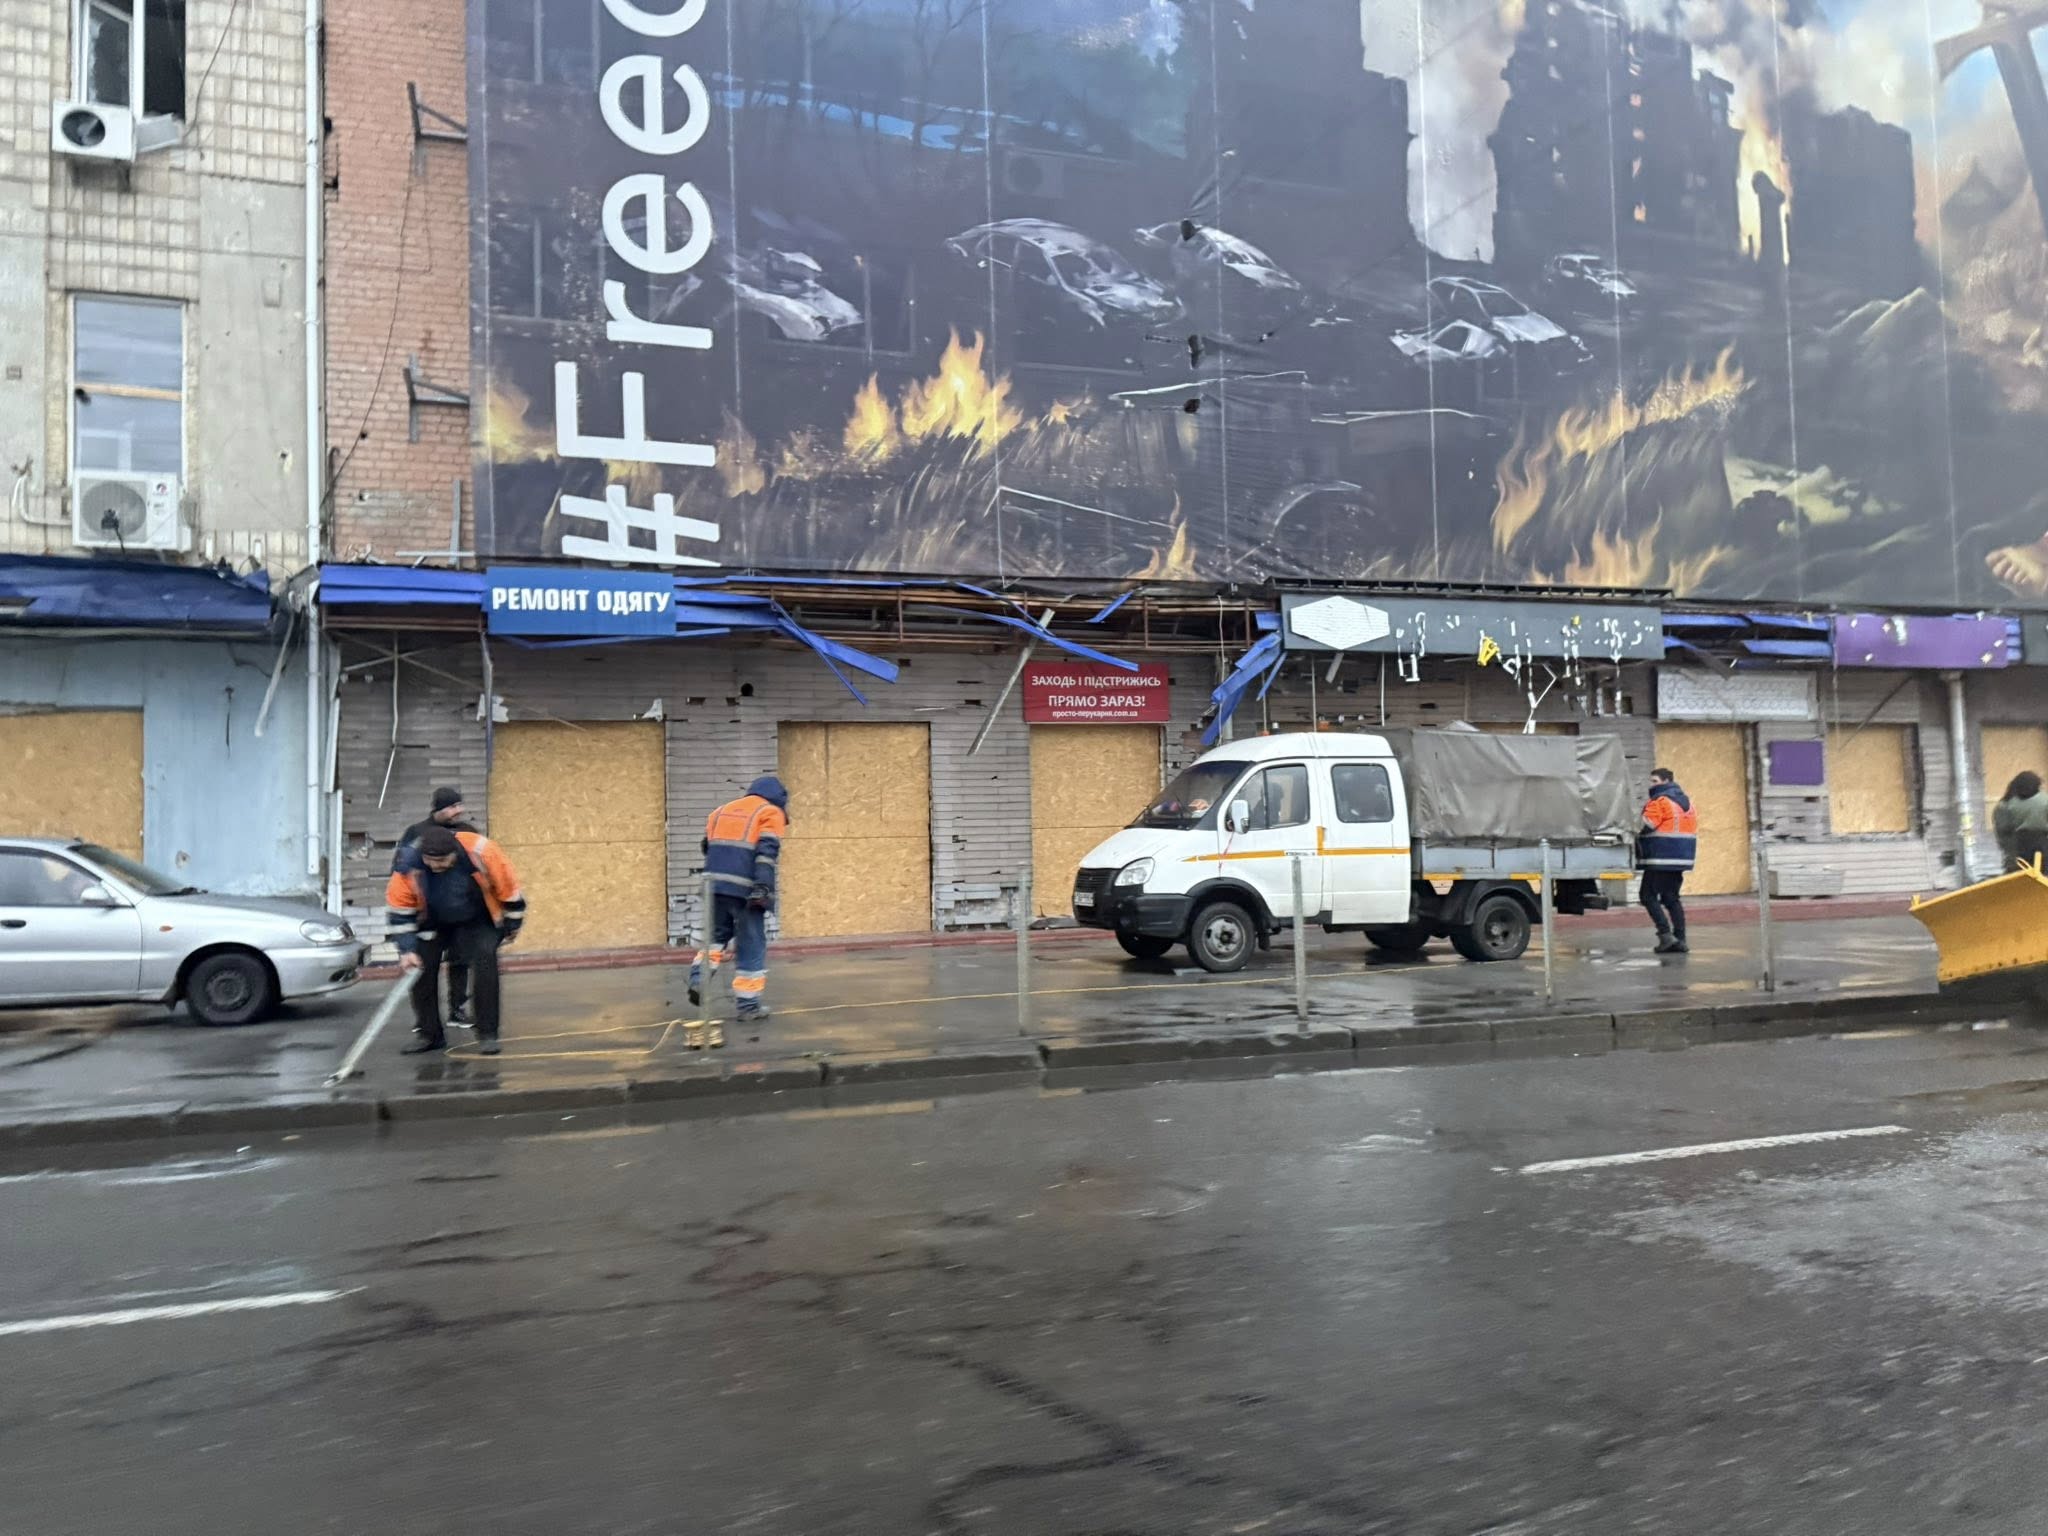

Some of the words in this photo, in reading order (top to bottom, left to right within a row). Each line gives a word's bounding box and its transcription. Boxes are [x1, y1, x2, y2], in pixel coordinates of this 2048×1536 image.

[492, 588, 589, 611] РЕМОНТ
[597, 590, 670, 615] ОДЯГУ
[1032, 676, 1076, 688] ЗАХОДЬ
[1084, 676, 1161, 688] ПІДСТРИЖИСЬ
[1049, 695, 1097, 706] ПРЯМО
[1100, 696, 1146, 707] ЗАРАЗ!
